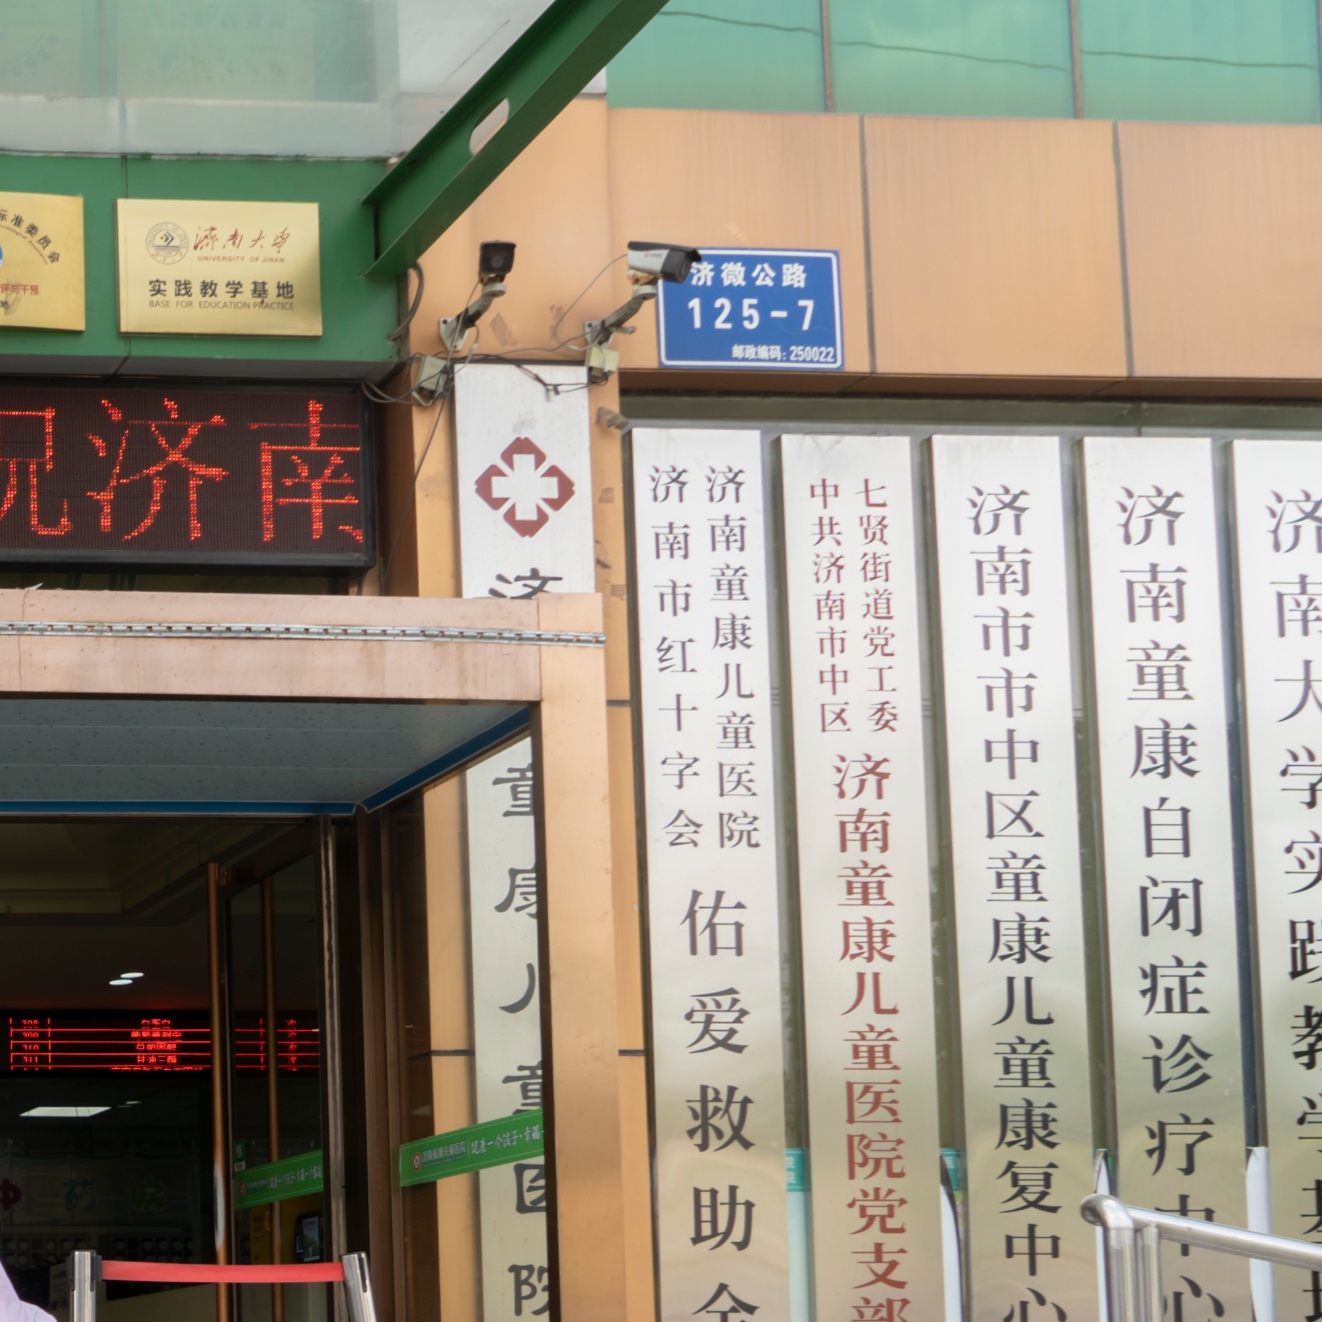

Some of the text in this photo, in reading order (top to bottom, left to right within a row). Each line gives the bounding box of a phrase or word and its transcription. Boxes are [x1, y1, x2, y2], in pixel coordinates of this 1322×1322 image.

[149, 279, 295, 299] 实践教学基地
[149, 299, 294, 311] BASE FOR EDUCATION PRACTICE
[688, 297, 814, 331] 125-7
[690, 261, 807, 288] 济微公路
[648, 464, 703, 850] 济南市红十字会
[705, 463, 761, 851] 济南童康儿童医院
[809, 477, 852, 734] 中共济南市中区
[856, 477, 900, 734] 七贤街道党工委
